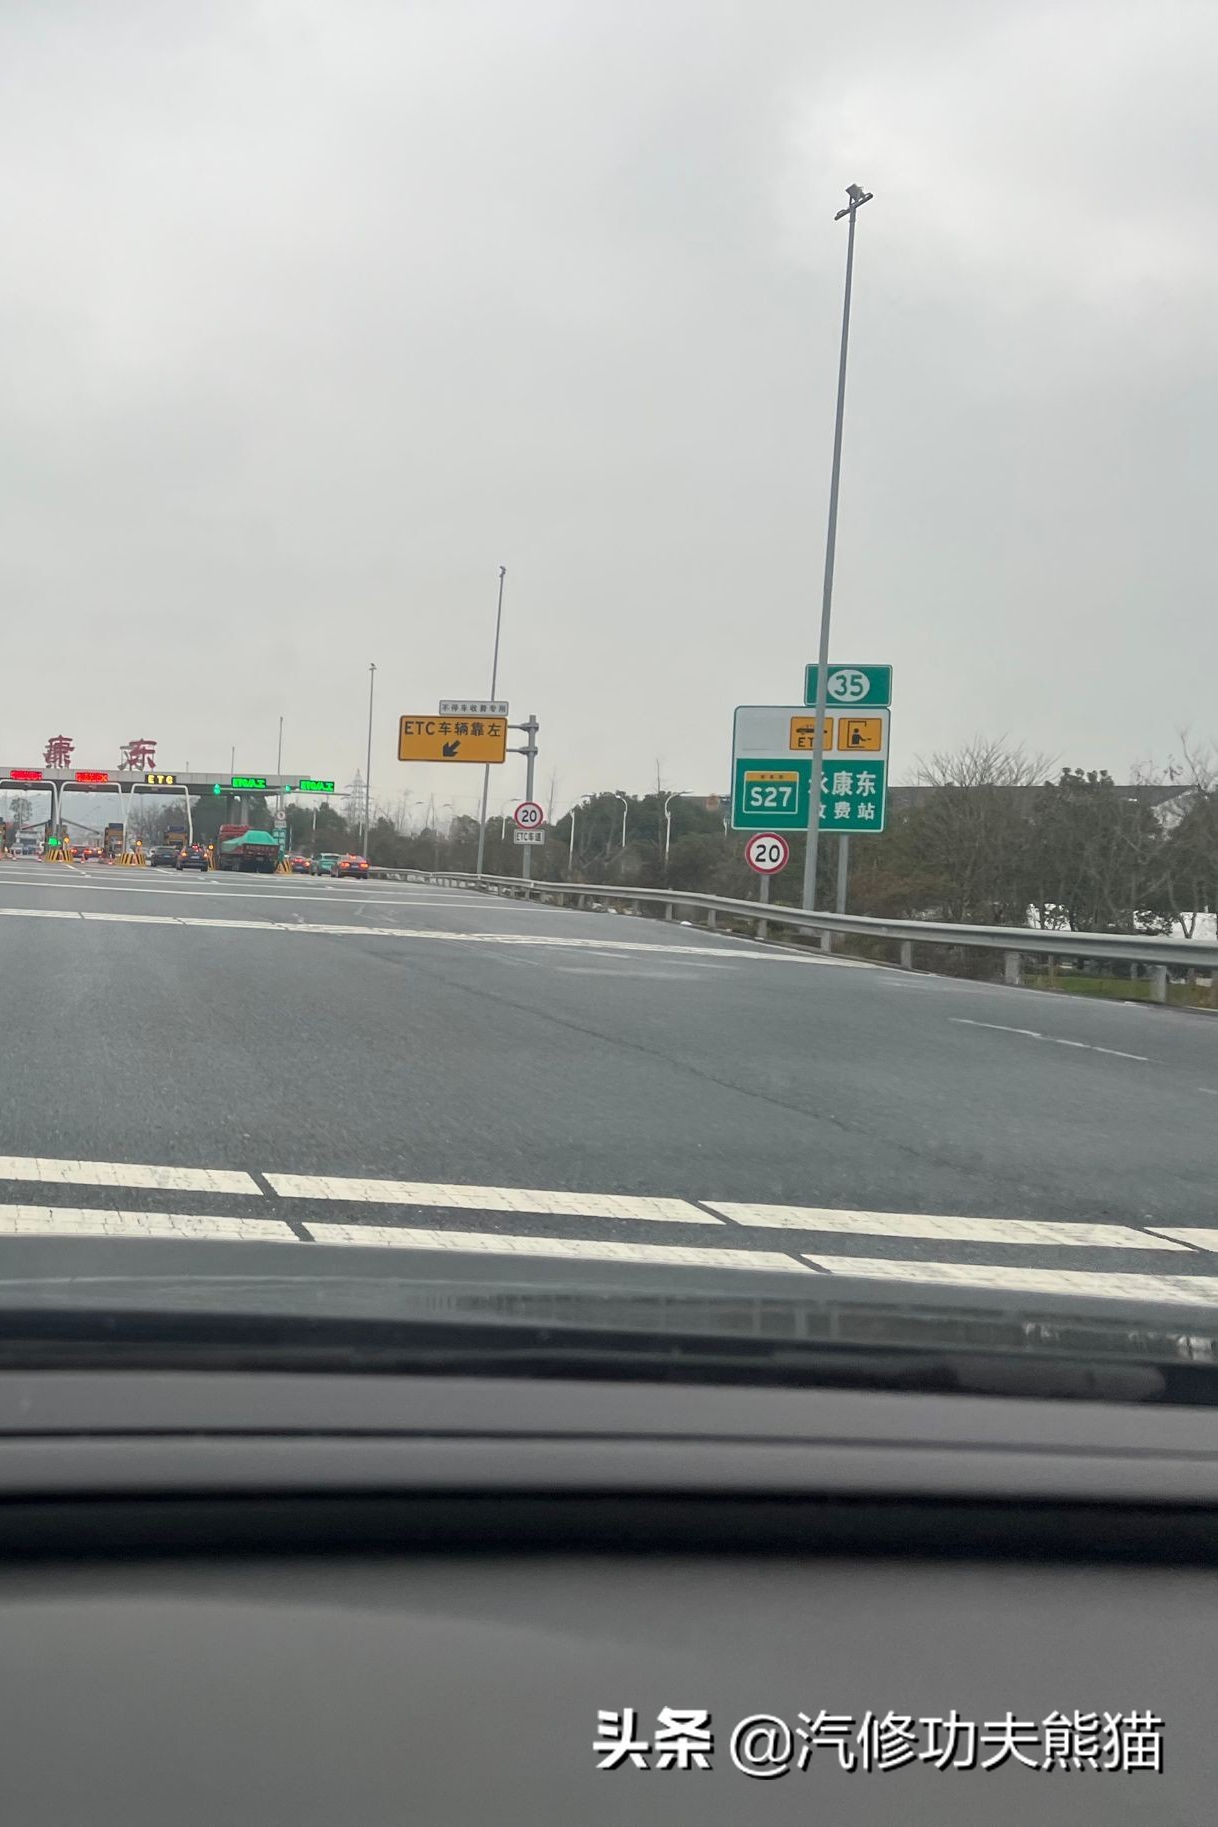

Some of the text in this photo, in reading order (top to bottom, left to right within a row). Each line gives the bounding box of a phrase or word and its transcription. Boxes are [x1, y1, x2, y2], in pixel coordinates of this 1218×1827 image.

[834, 674, 865, 697] 35
[441, 703, 507, 713] 不停车收费专用
[403, 720, 501, 737] ETC车辆靠左
[797, 736, 815, 748] ET
[148, 774, 174, 785] ETC
[750, 786, 792, 807] S27
[521, 809, 537, 823] 20
[754, 844, 781, 863] 20
